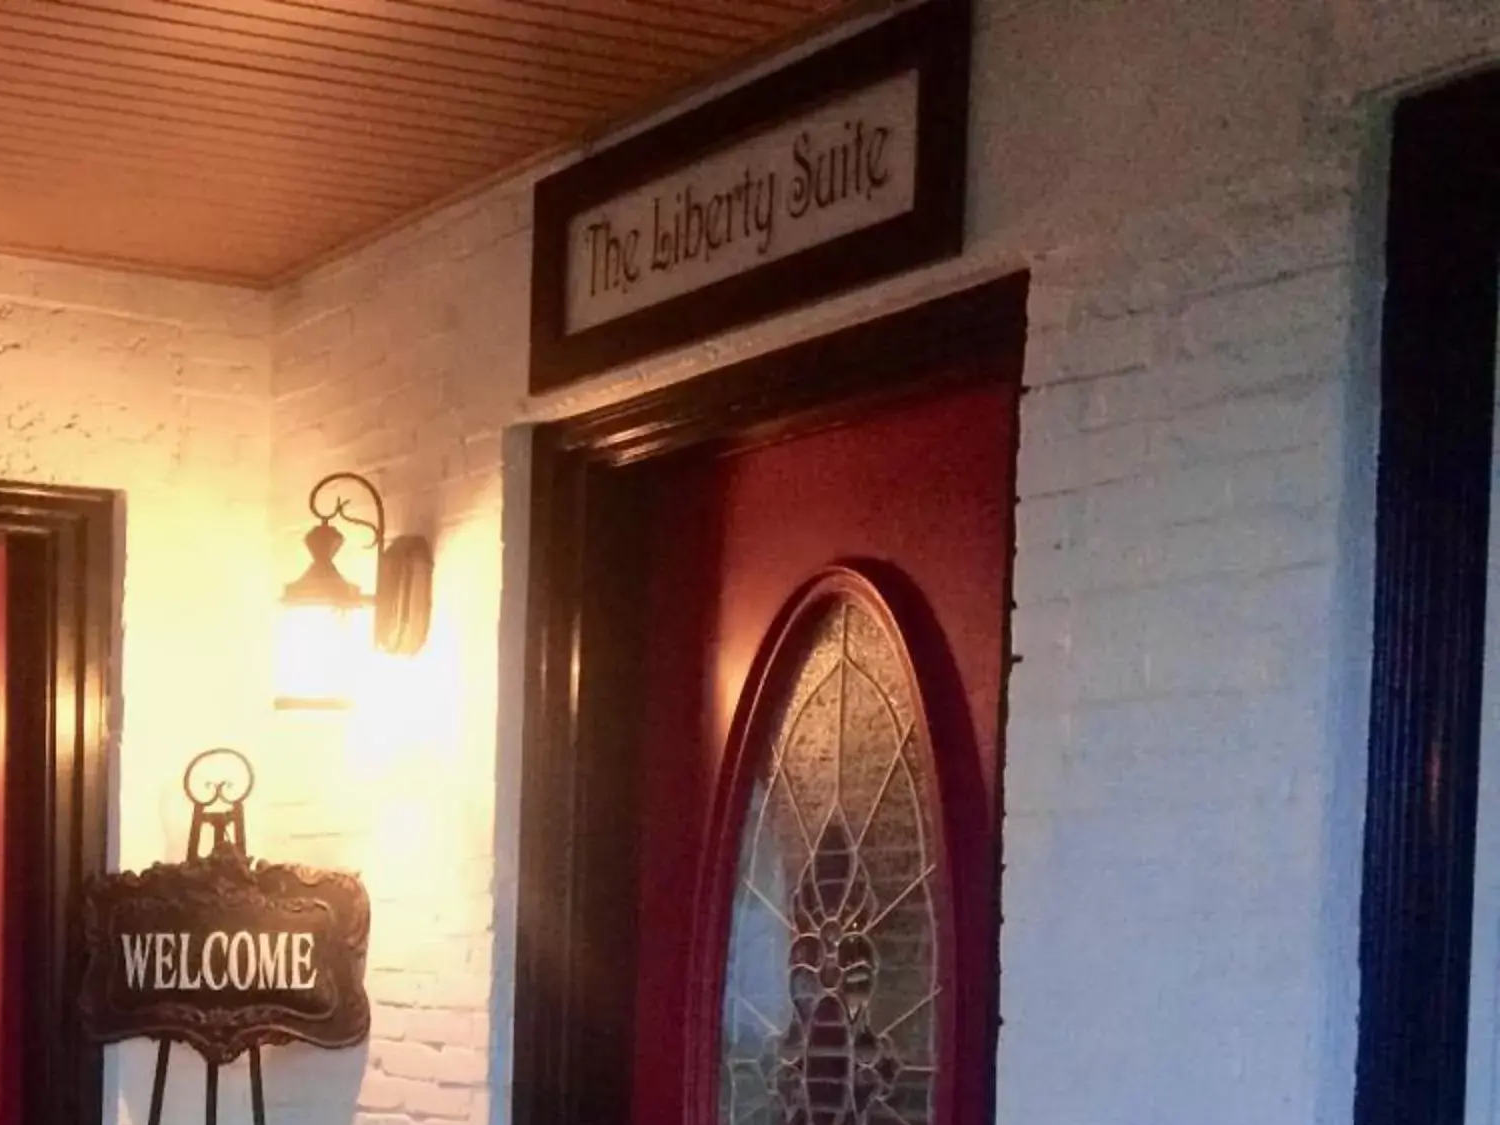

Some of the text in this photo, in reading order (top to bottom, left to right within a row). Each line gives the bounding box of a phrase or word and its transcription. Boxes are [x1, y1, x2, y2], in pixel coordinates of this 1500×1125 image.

[585, 120, 890, 296] The Liberty Suite
[121, 931, 318, 990] WELCOME
